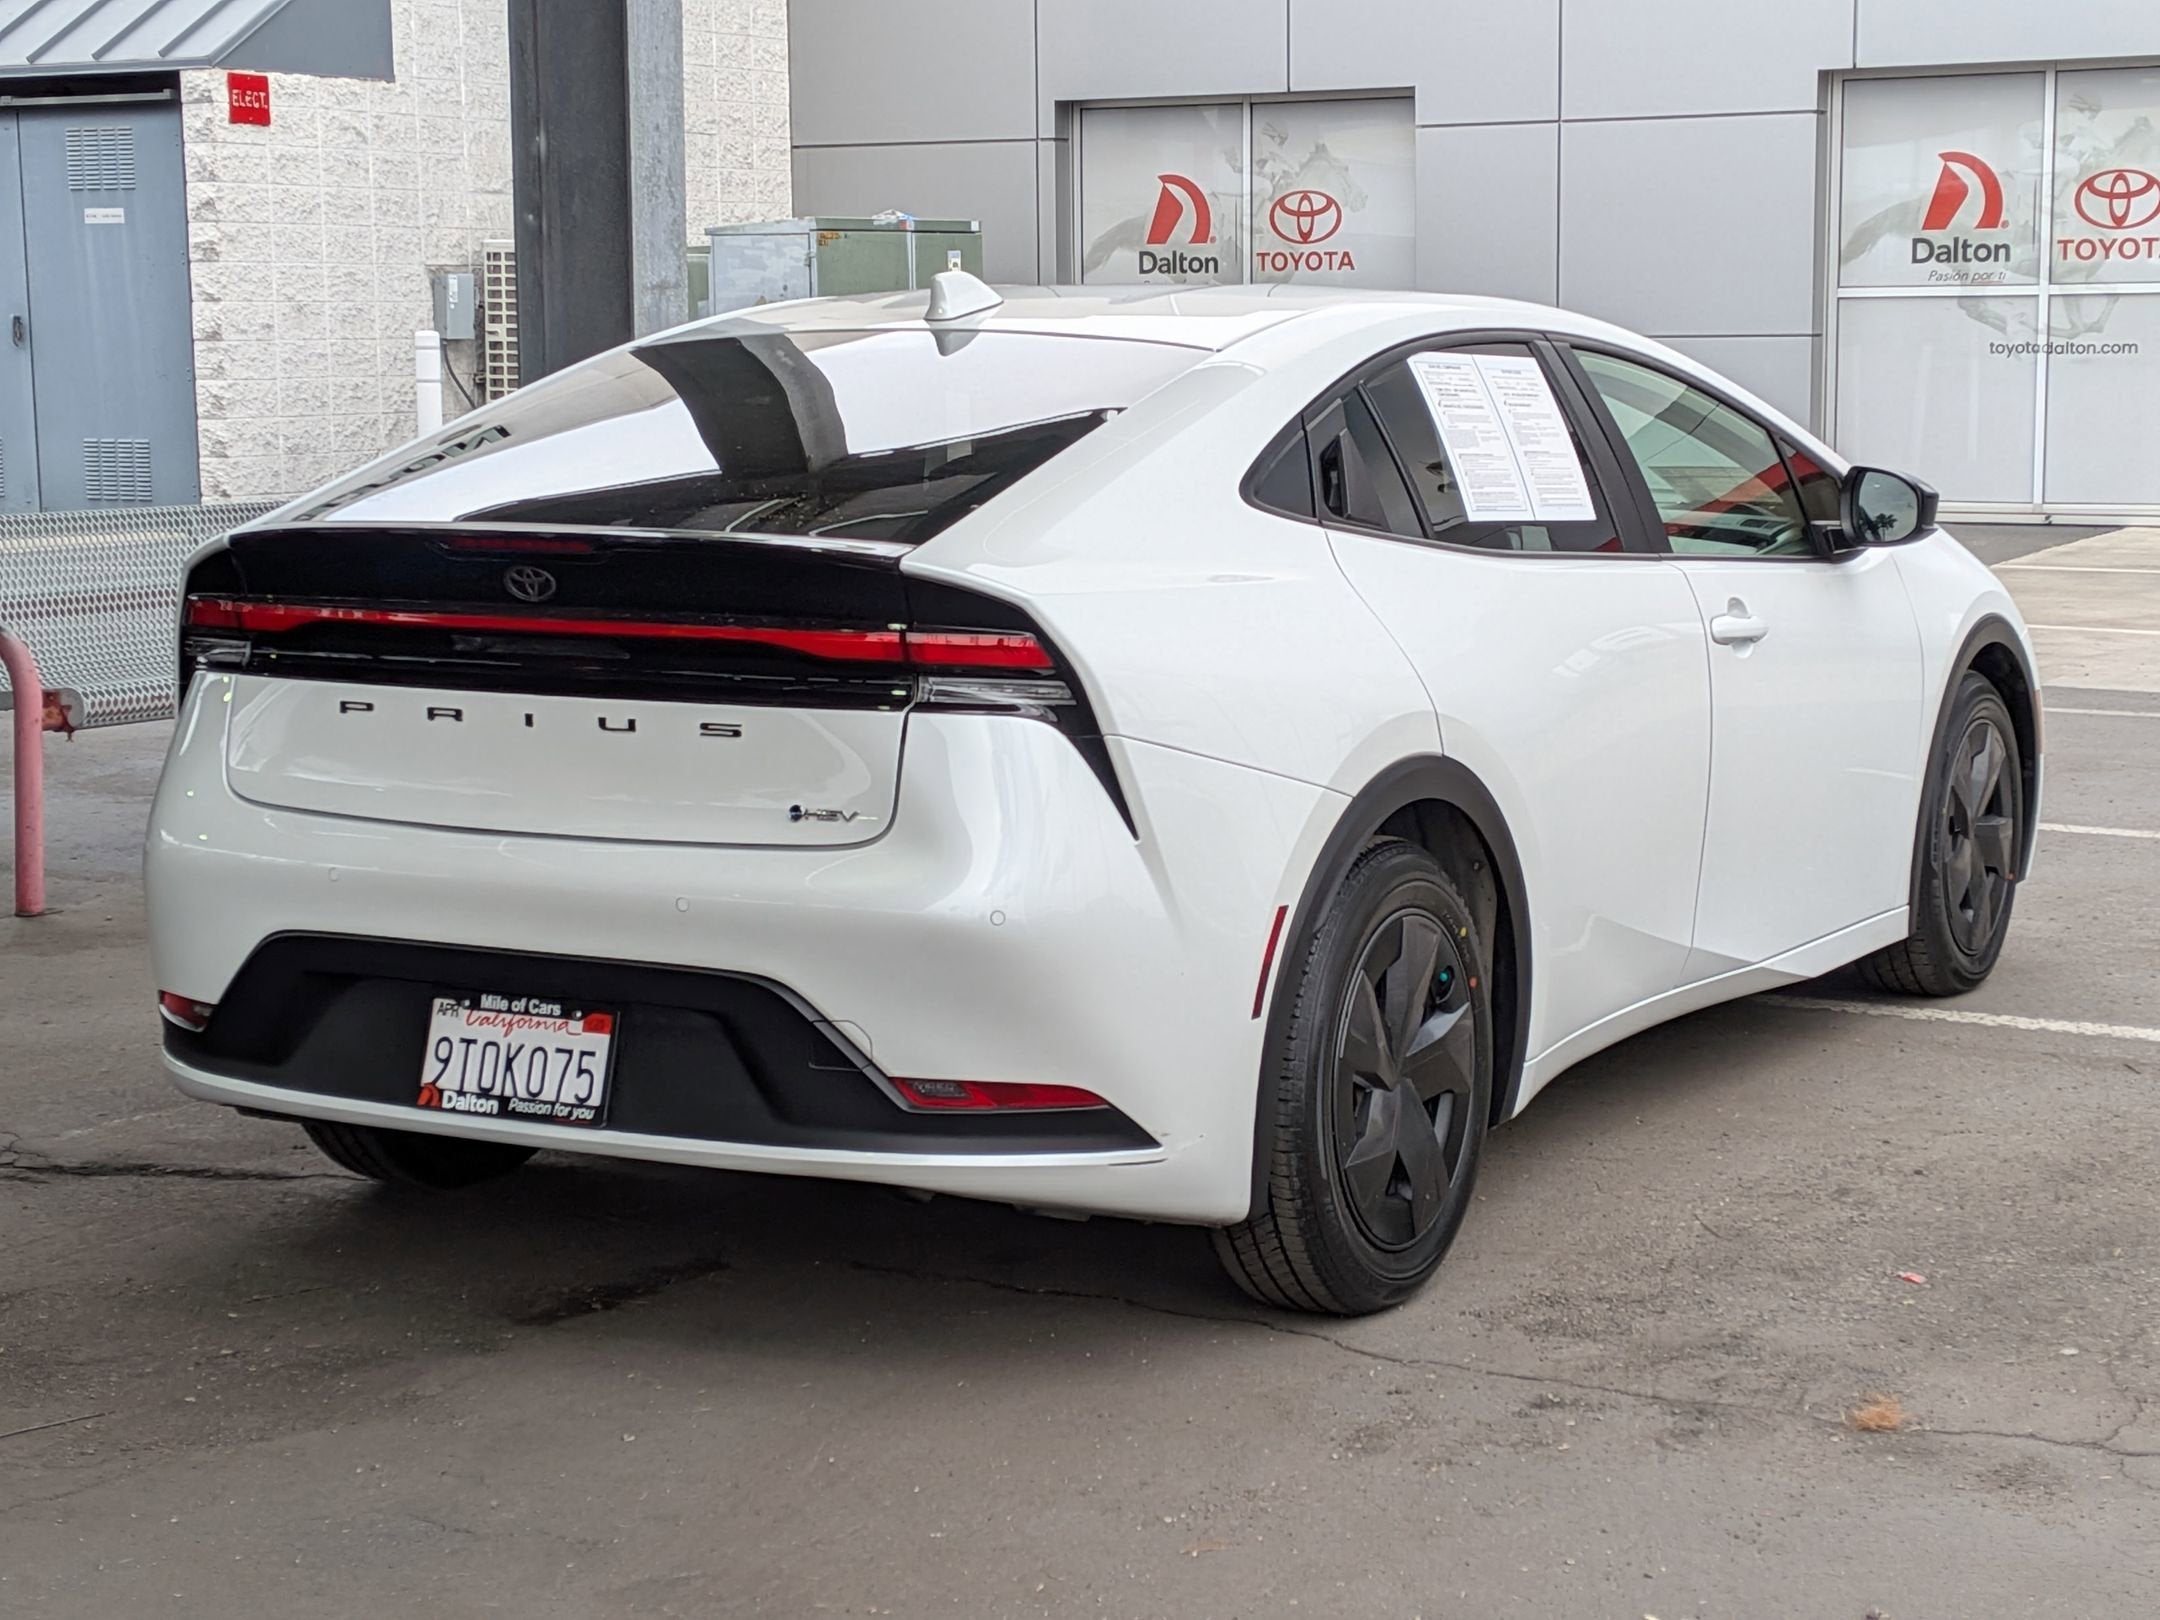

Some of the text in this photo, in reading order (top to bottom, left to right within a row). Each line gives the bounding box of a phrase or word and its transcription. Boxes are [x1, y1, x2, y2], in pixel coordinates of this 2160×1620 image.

[232, 89, 268, 109] ELECT.
[1256, 250, 1355, 271] TOYOTA
[1911, 237, 2011, 263] Dalton
[2057, 237, 2160, 261] TOYOT
[1138, 250, 1219, 274] Dalton
[1928, 269, 1969, 282] Pasión
[1971, 271, 1994, 284] por
[340, 699, 743, 738] PRIUS
[480, 994, 562, 1016] Mile of Cars
[466, 1009, 582, 1038] California
[441, 1089, 499, 1115] Dalton
[507, 1097, 596, 1120] Passion for you
